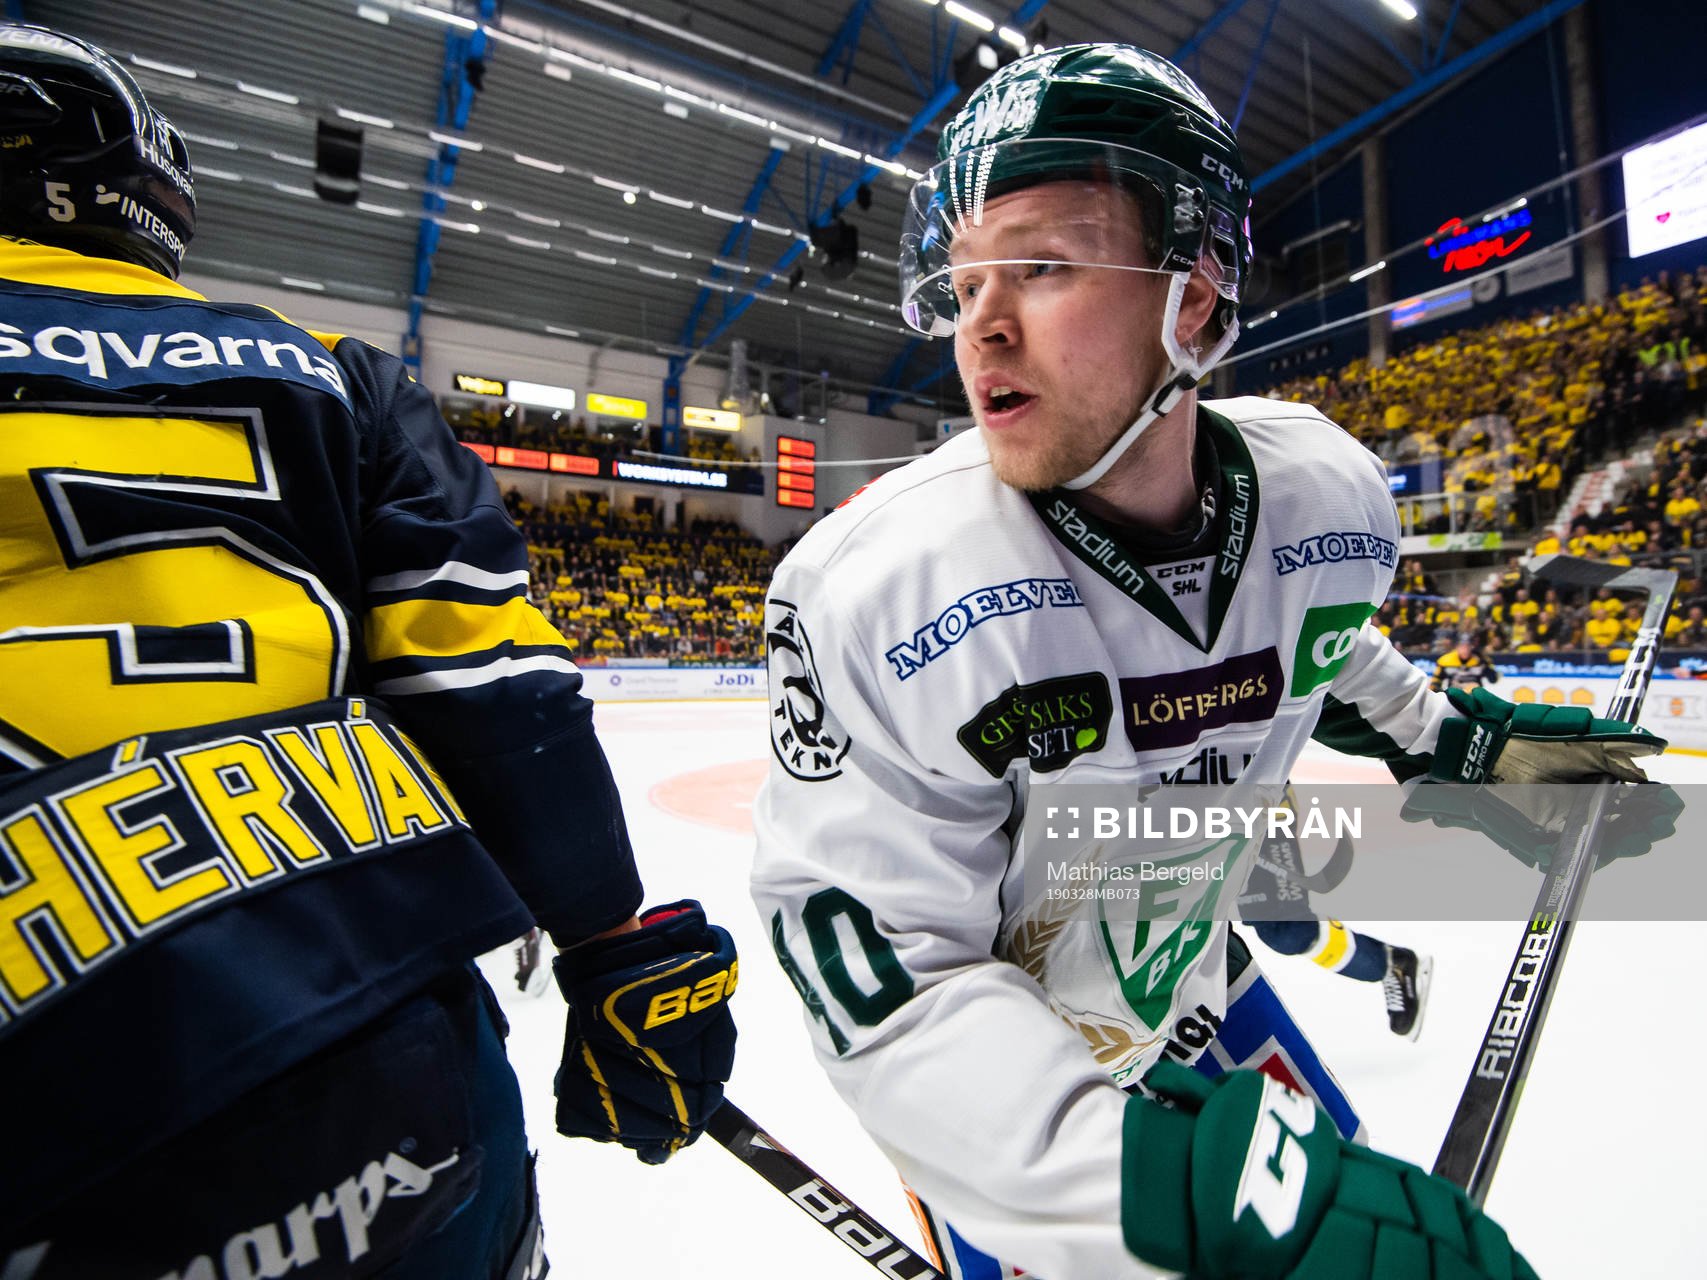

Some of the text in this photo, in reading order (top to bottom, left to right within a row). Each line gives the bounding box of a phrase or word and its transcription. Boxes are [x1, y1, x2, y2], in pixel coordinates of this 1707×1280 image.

[1201, 153, 1244, 190] CCM
[45, 181, 76, 223] 5
[1220, 474, 1250, 580] stadium
[1047, 500, 1146, 596] stadium
[1157, 561, 1206, 579] CCM
[1172, 578, 1202, 597] SHL
[1028, 725, 1075, 759] SET
[1461, 724, 1485, 779] CCM
[1476, 746, 1488, 767] PRO
